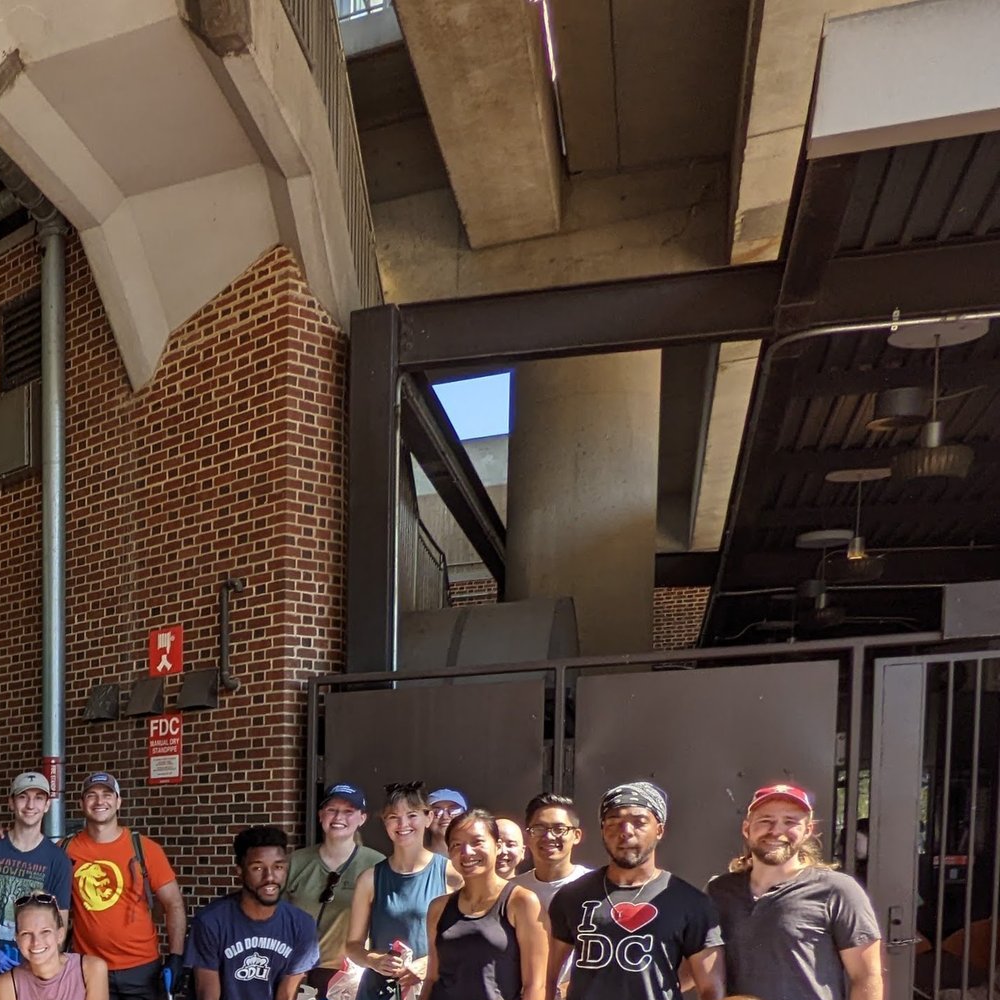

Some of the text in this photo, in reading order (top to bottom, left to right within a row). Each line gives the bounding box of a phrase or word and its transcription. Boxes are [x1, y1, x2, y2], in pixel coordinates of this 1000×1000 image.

[150, 717, 179, 737] FDC
[152, 746, 177, 754] STANDPIPE
[577, 901, 602, 932] I
[224, 936, 292, 959] OLD DOMINION
[576, 934, 653, 972] DC
[235, 967, 270, 980] ODU
